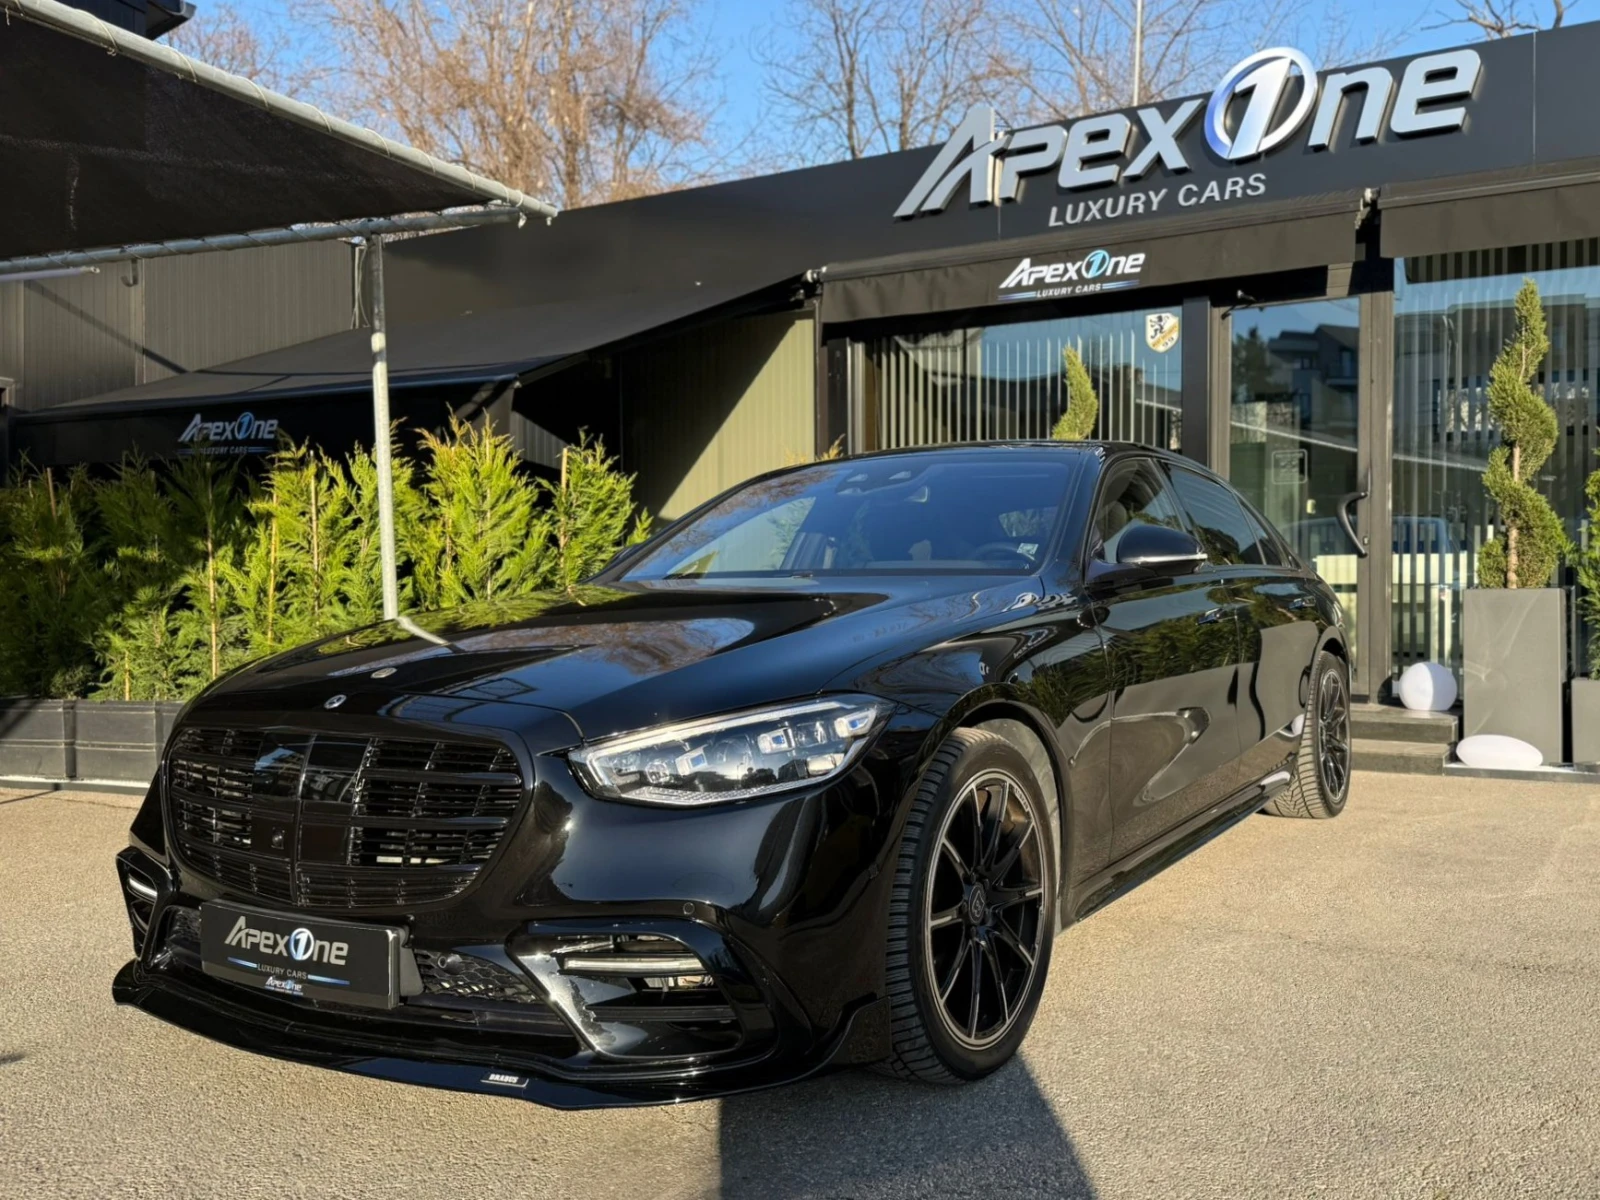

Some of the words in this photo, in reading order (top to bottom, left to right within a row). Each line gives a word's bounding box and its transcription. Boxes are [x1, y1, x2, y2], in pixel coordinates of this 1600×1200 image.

[1048, 188, 1168, 227] LUXURY
[1178, 173, 1267, 206] CARS
[1036, 286, 1072, 298] LUXURY
[1075, 283, 1101, 294] CARS
[257, 963, 285, 976] LUXURY
[286, 968, 308, 980] CARS
